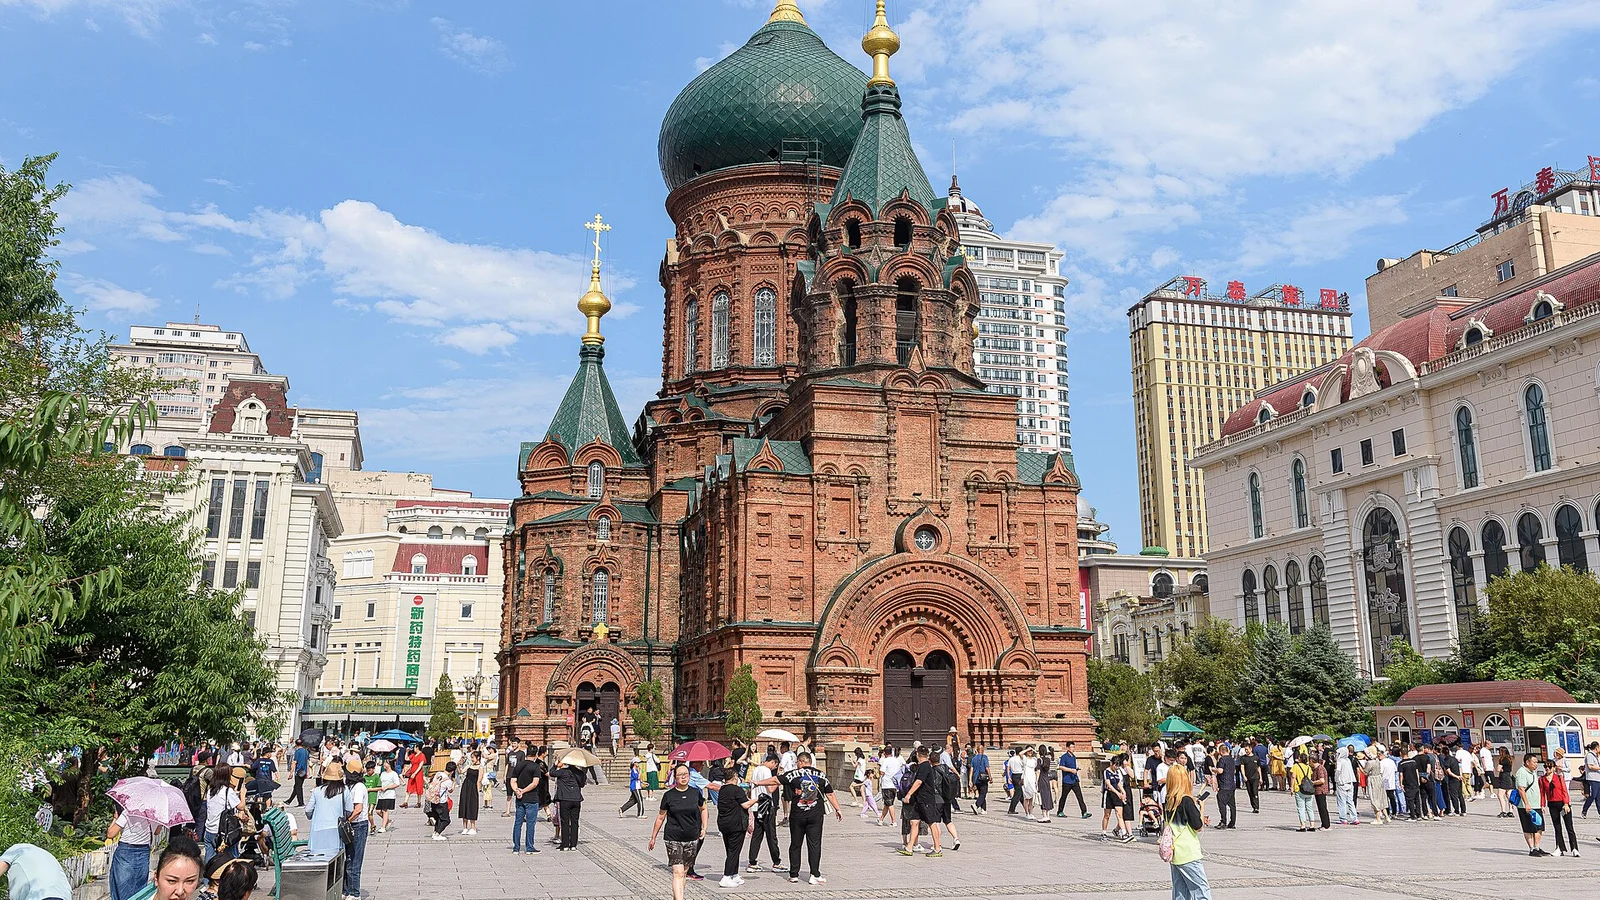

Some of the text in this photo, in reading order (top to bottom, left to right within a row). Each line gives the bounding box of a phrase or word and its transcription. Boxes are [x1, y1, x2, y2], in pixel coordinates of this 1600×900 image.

[1182, 276, 1339, 309] 万泰集团
[405, 607, 424, 690] 新药特药商店
